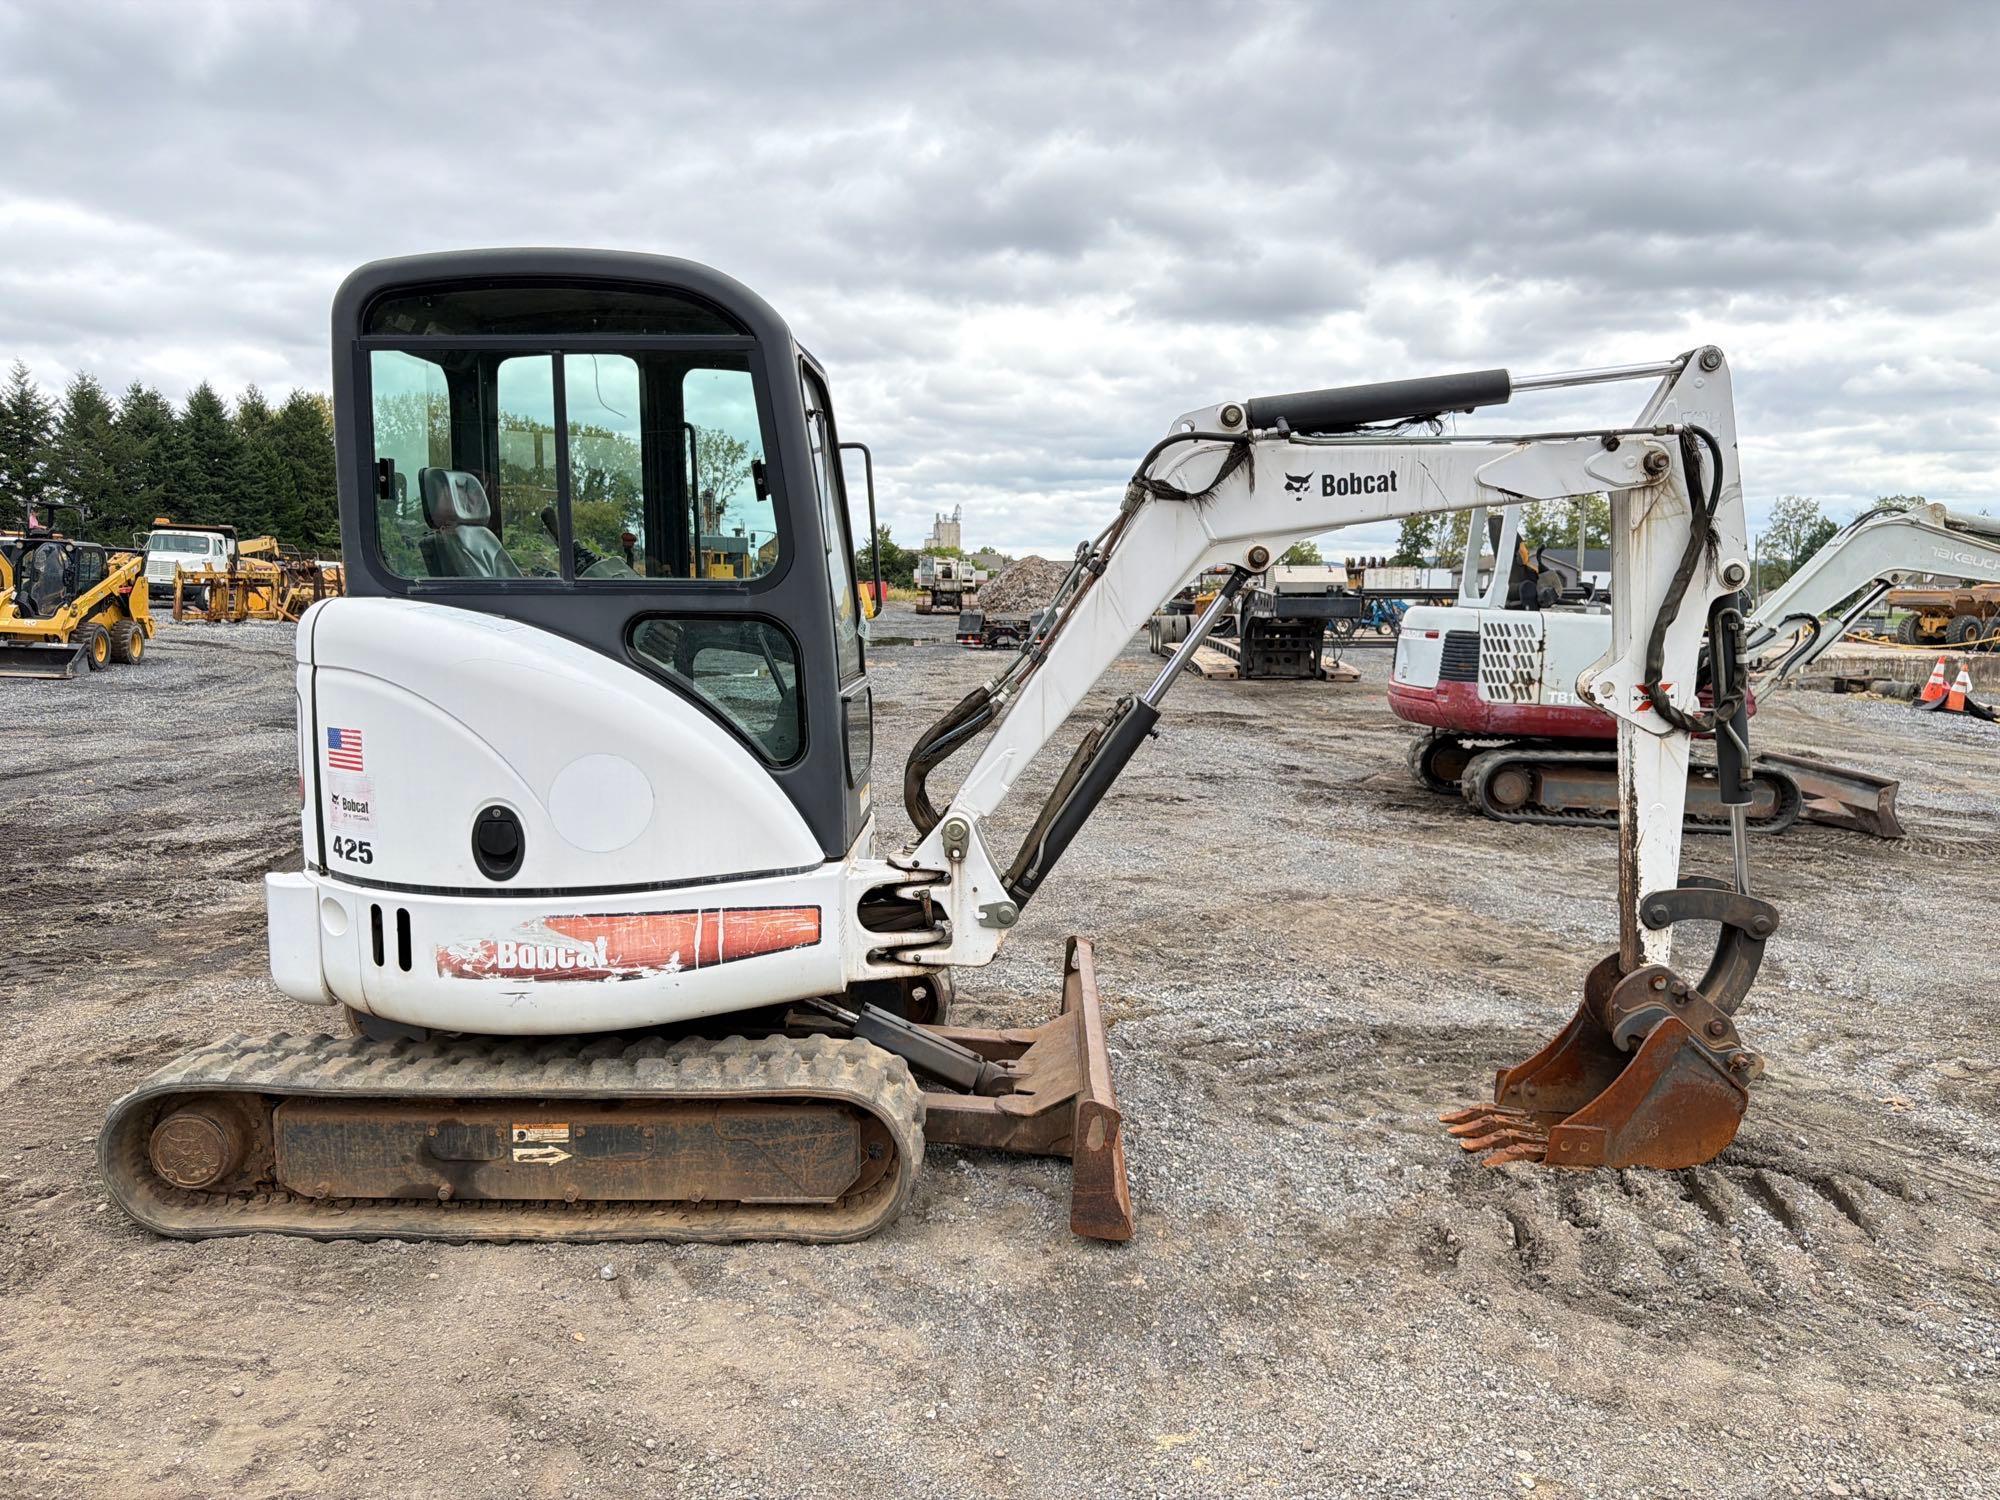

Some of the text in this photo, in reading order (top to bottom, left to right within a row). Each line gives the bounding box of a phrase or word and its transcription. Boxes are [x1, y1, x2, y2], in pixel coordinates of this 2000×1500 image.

[1321, 470, 1397, 497] Bobcat
[342, 797, 369, 814] Bobcat
[333, 835, 373, 864] 425
[497, 936, 609, 970] Bobcat
